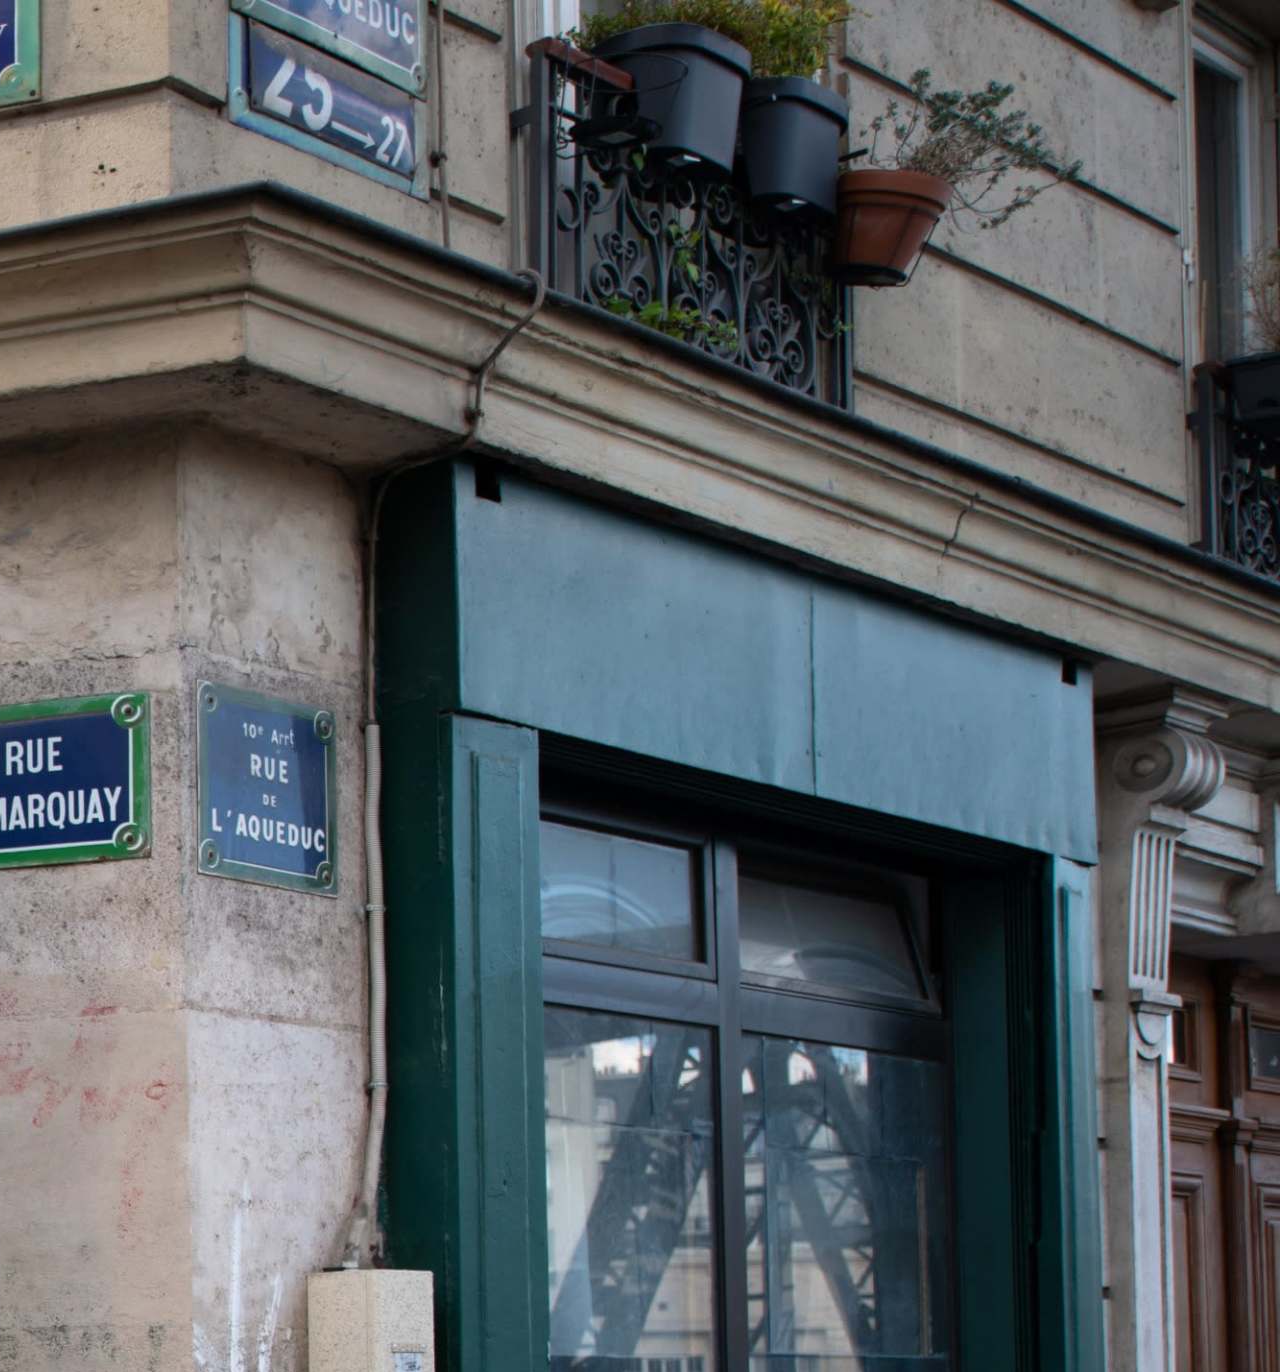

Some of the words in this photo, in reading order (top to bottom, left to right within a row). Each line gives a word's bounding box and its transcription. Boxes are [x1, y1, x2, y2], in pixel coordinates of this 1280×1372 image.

[375, 115, 410, 167] 27
[271, 729, 295, 746] Arrt
[4, 736, 64, 776] RUE
[250, 753, 289, 784] RUE
[262, 793, 277, 808] DE
[211, 807, 326, 852] L'AQUEDUC
